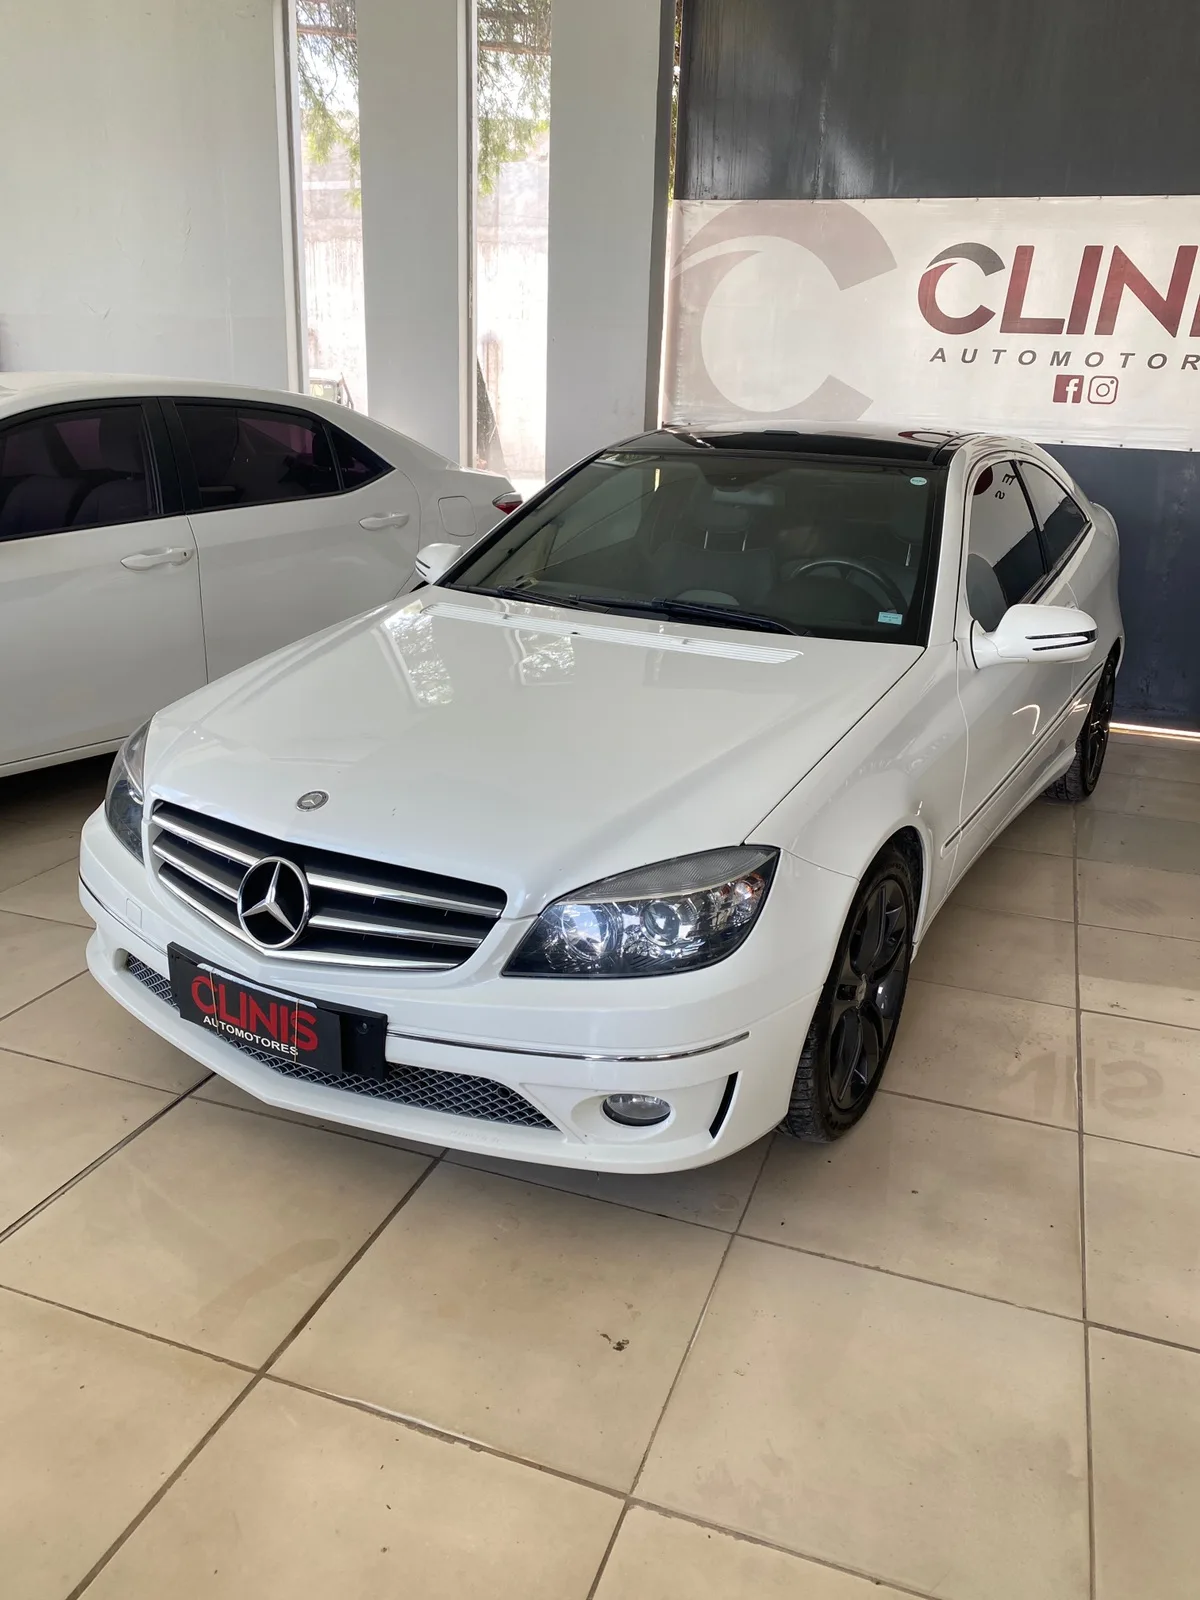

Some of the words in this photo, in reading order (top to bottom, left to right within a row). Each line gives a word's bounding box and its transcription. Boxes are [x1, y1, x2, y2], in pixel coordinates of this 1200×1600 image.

[917, 242, 1200, 338] CLIN
[929, 347, 1200, 370] AUTOMOTOR
[191, 975, 319, 1051] CLINIS
[203, 1015, 299, 1056] AUTOMOTORES
